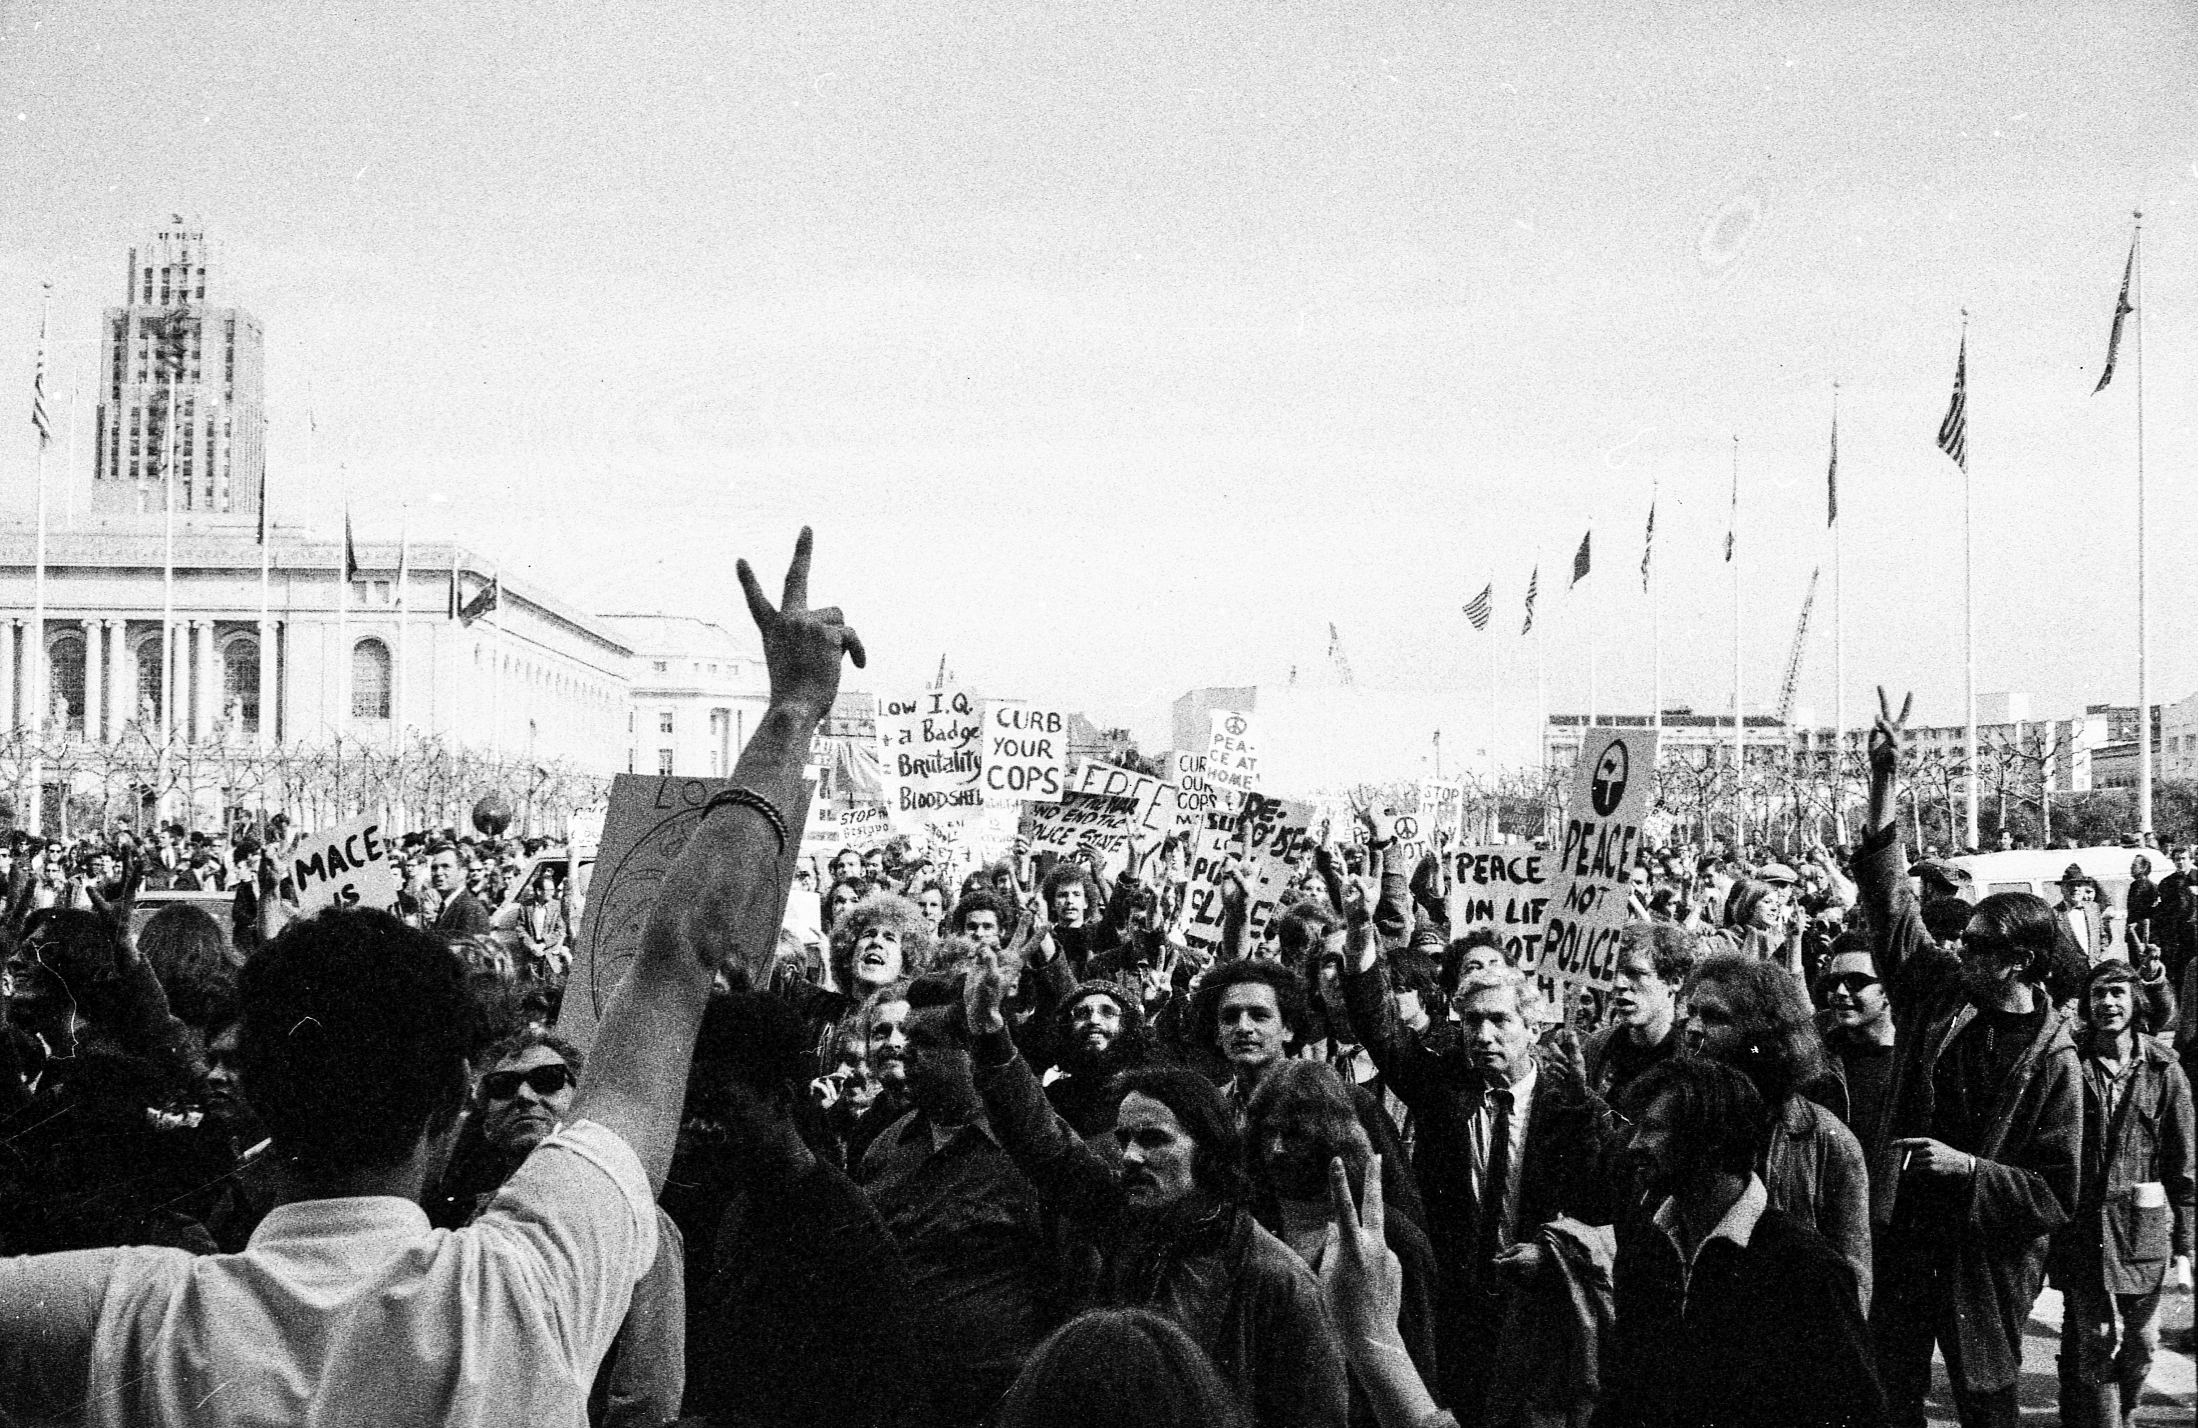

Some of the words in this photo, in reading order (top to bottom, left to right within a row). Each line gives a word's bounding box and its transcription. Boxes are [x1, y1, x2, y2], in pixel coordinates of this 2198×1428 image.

[922, 718, 981, 750] Badge
[996, 707, 1062, 733] CURB
[993, 737, 1054, 760] YOUR
[1235, 756, 1257, 771] AT
[987, 765, 1060, 795] COPS
[839, 807, 877, 826] STOP
[295, 825, 384, 891] MACE
[1560, 819, 1638, 884] PEACE
[1455, 852, 1547, 885] PEACE
[333, 883, 360, 908] IS
[1465, 896, 1495, 924] IN
[1563, 881, 1611, 915] NOT
[1540, 918, 1621, 982] POLICE
